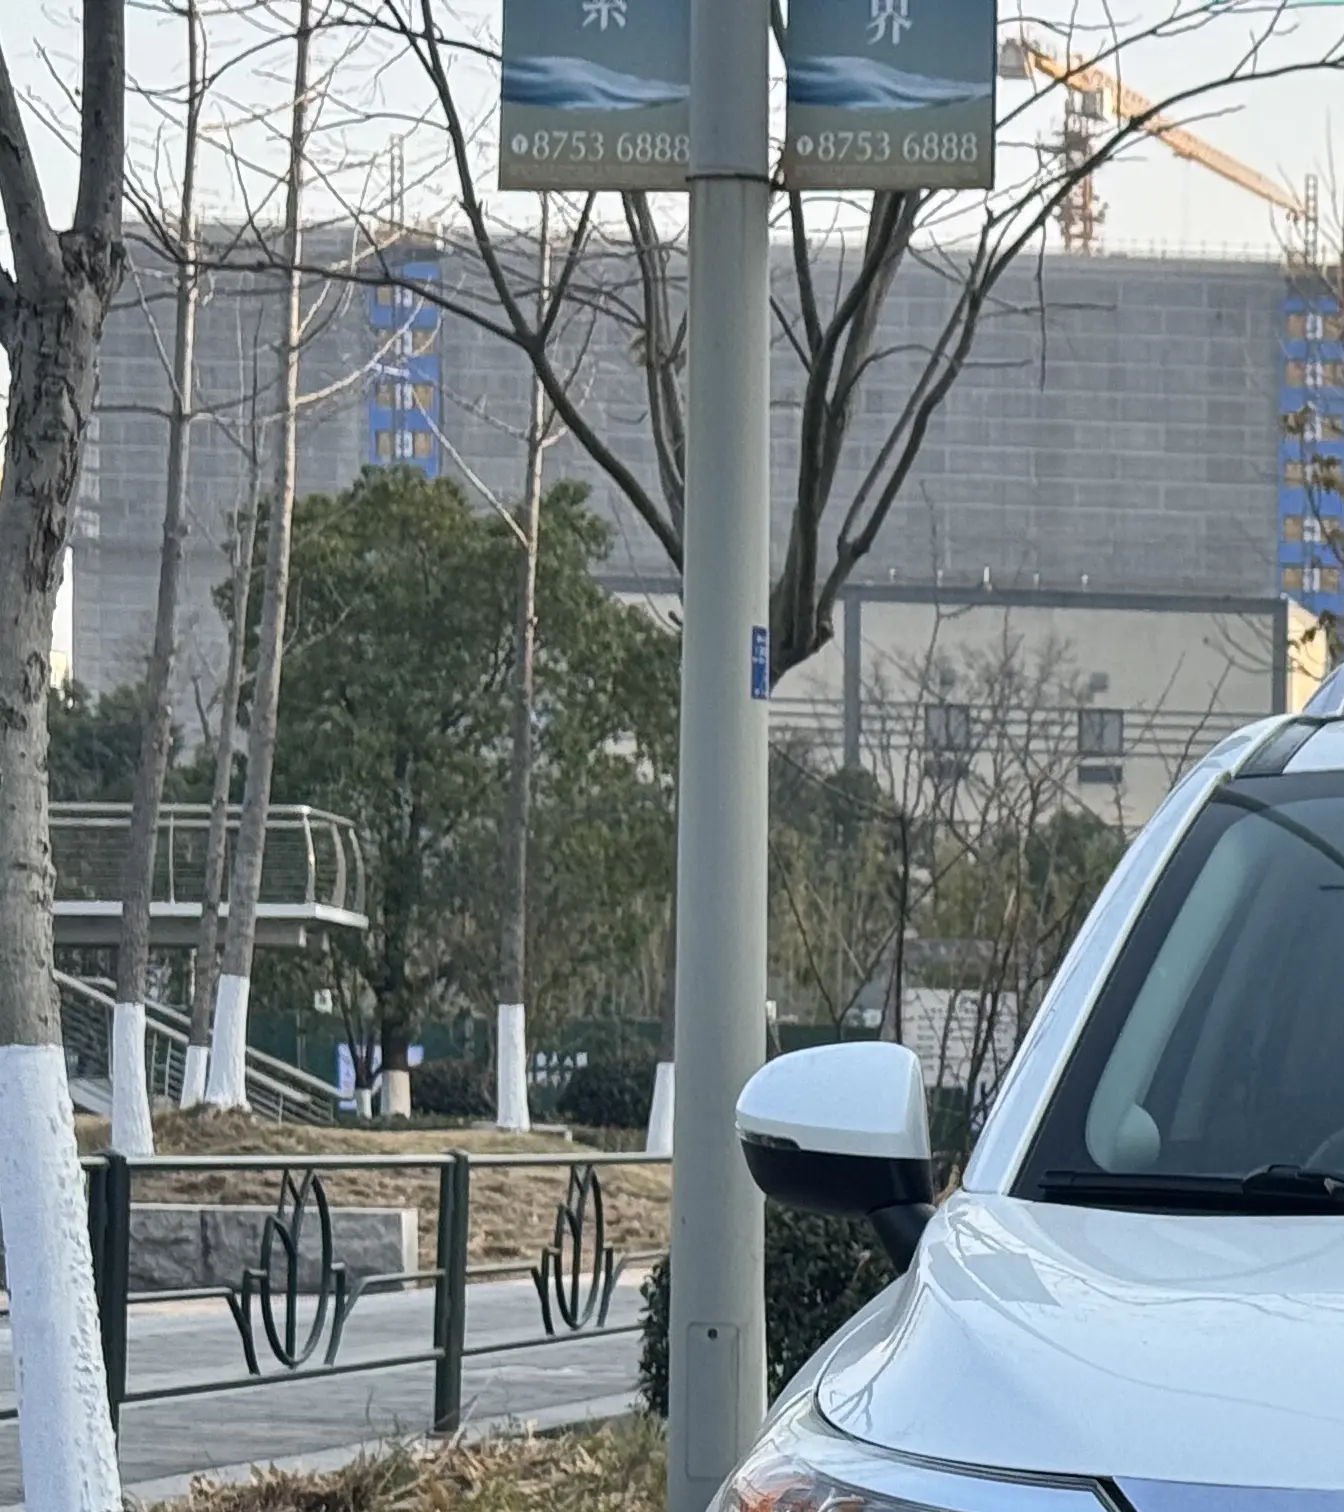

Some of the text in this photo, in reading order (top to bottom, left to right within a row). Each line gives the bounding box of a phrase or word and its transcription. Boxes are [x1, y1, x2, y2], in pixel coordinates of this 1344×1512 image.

[532, 130, 690, 164] 8753 6888
[817, 130, 978, 163] 8753 6888
